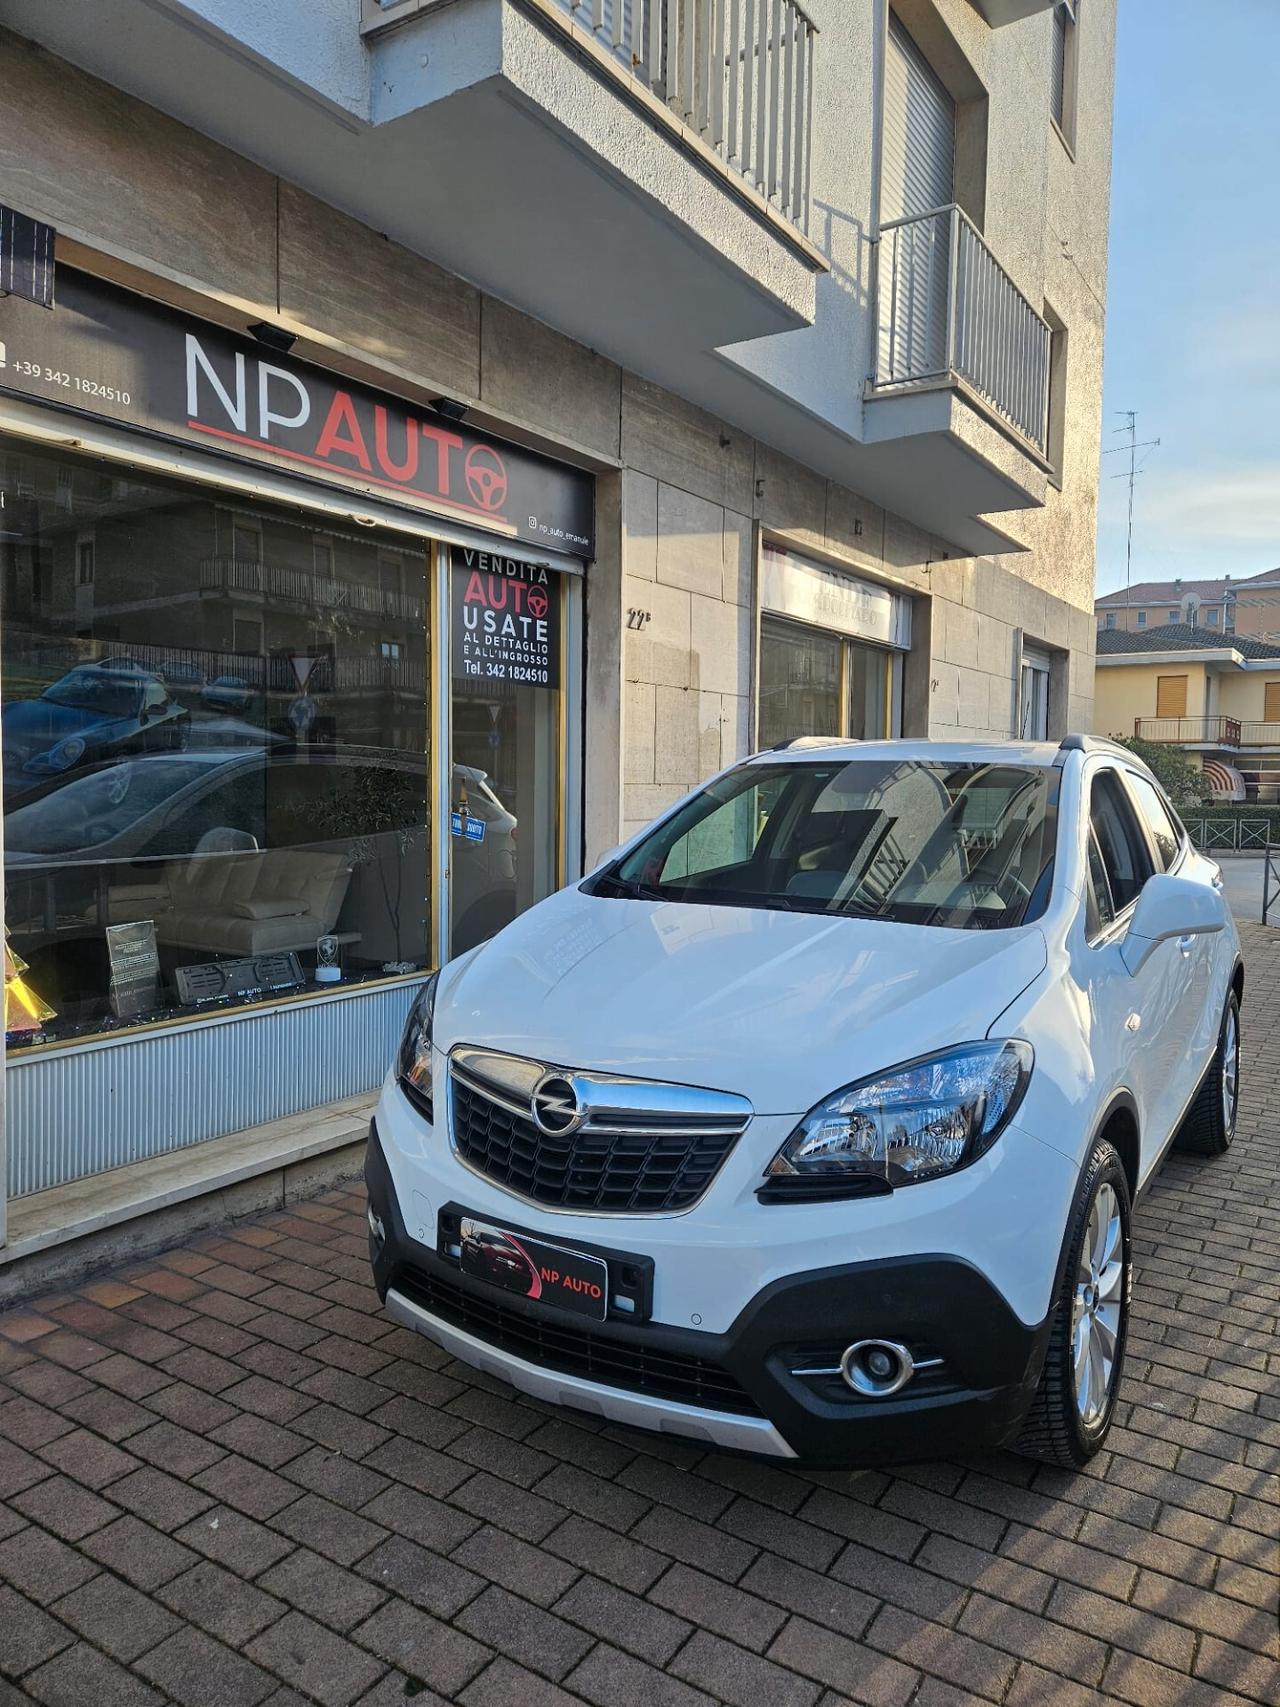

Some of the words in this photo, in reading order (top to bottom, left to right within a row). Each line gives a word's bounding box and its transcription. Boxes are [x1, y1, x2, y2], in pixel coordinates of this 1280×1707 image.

[12, 361, 41, 377] +39
[44, 368, 71, 387] 342
[74, 377, 131, 405] 1824510
[185, 333, 311, 440] NP
[314, 390, 508, 511] AUTO
[463, 548, 548, 584] VENDITA
[464, 571, 548, 618] AUTO
[463, 605, 548, 642] USATE
[463, 631, 479, 644] AL
[485, 634, 548, 654] DETTAGLIO
[463, 645, 469, 654] E
[475, 646, 548, 666] ALL'INGROSSO
[463, 659, 483, 675] Tel.
[486, 663, 505, 678] 342
[508, 665, 548, 683] 1824510
[541, 1266, 559, 1284] NP
[563, 1275, 602, 1299] AUTO
